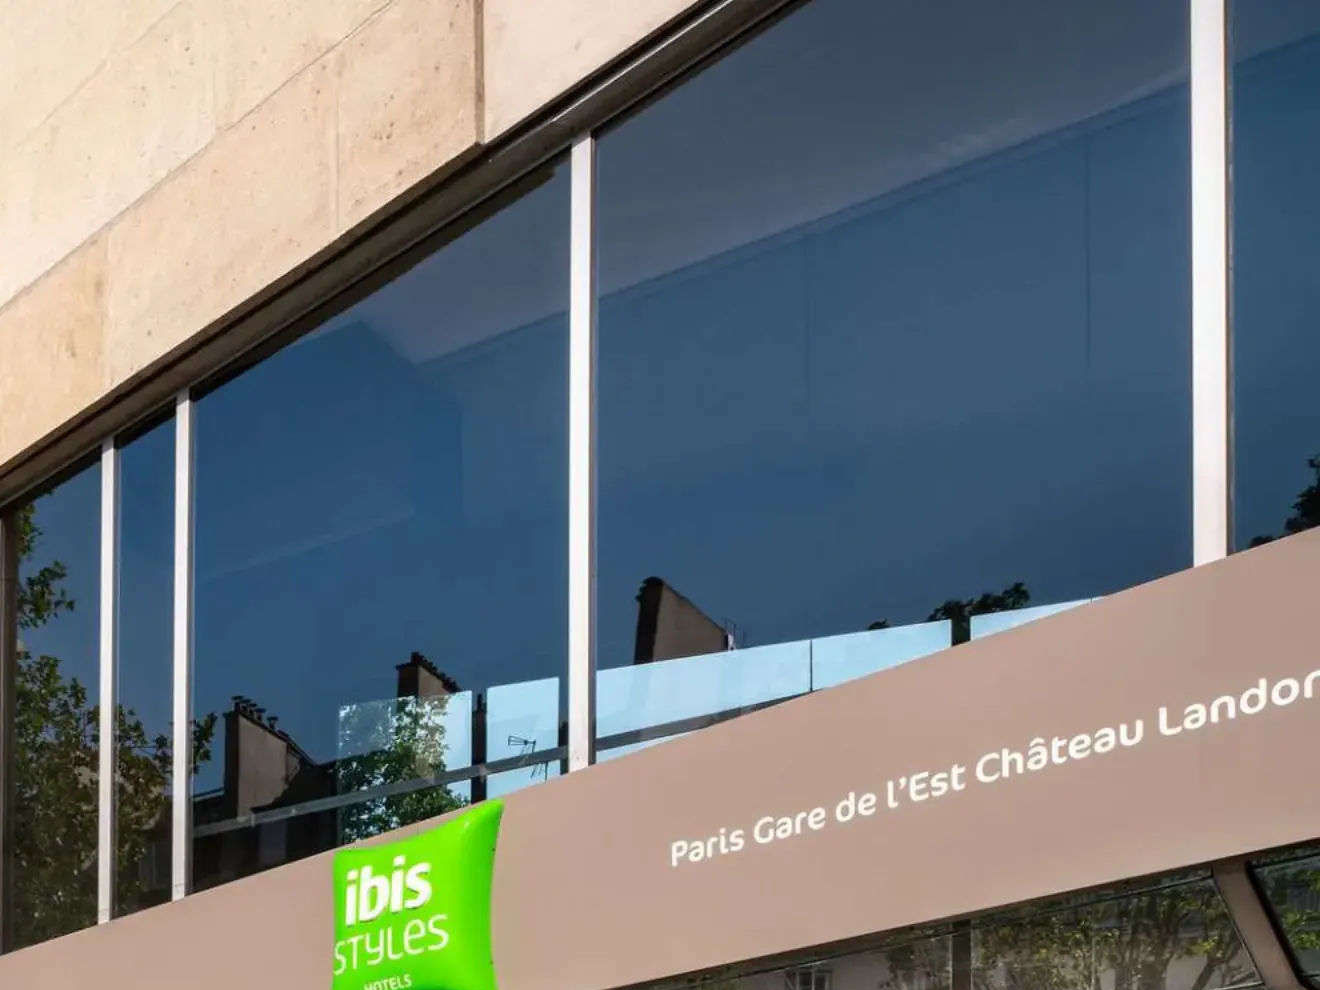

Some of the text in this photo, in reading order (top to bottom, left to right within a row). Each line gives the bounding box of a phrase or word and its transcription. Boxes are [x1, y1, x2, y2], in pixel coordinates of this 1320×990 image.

[671, 827, 745, 867] Paris
[753, 807, 827, 844] Gare
[835, 791, 877, 822] de
[886, 764, 966, 809] l'Est
[975, 718, 1144, 783] Château
[345, 855, 433, 927] ibis
